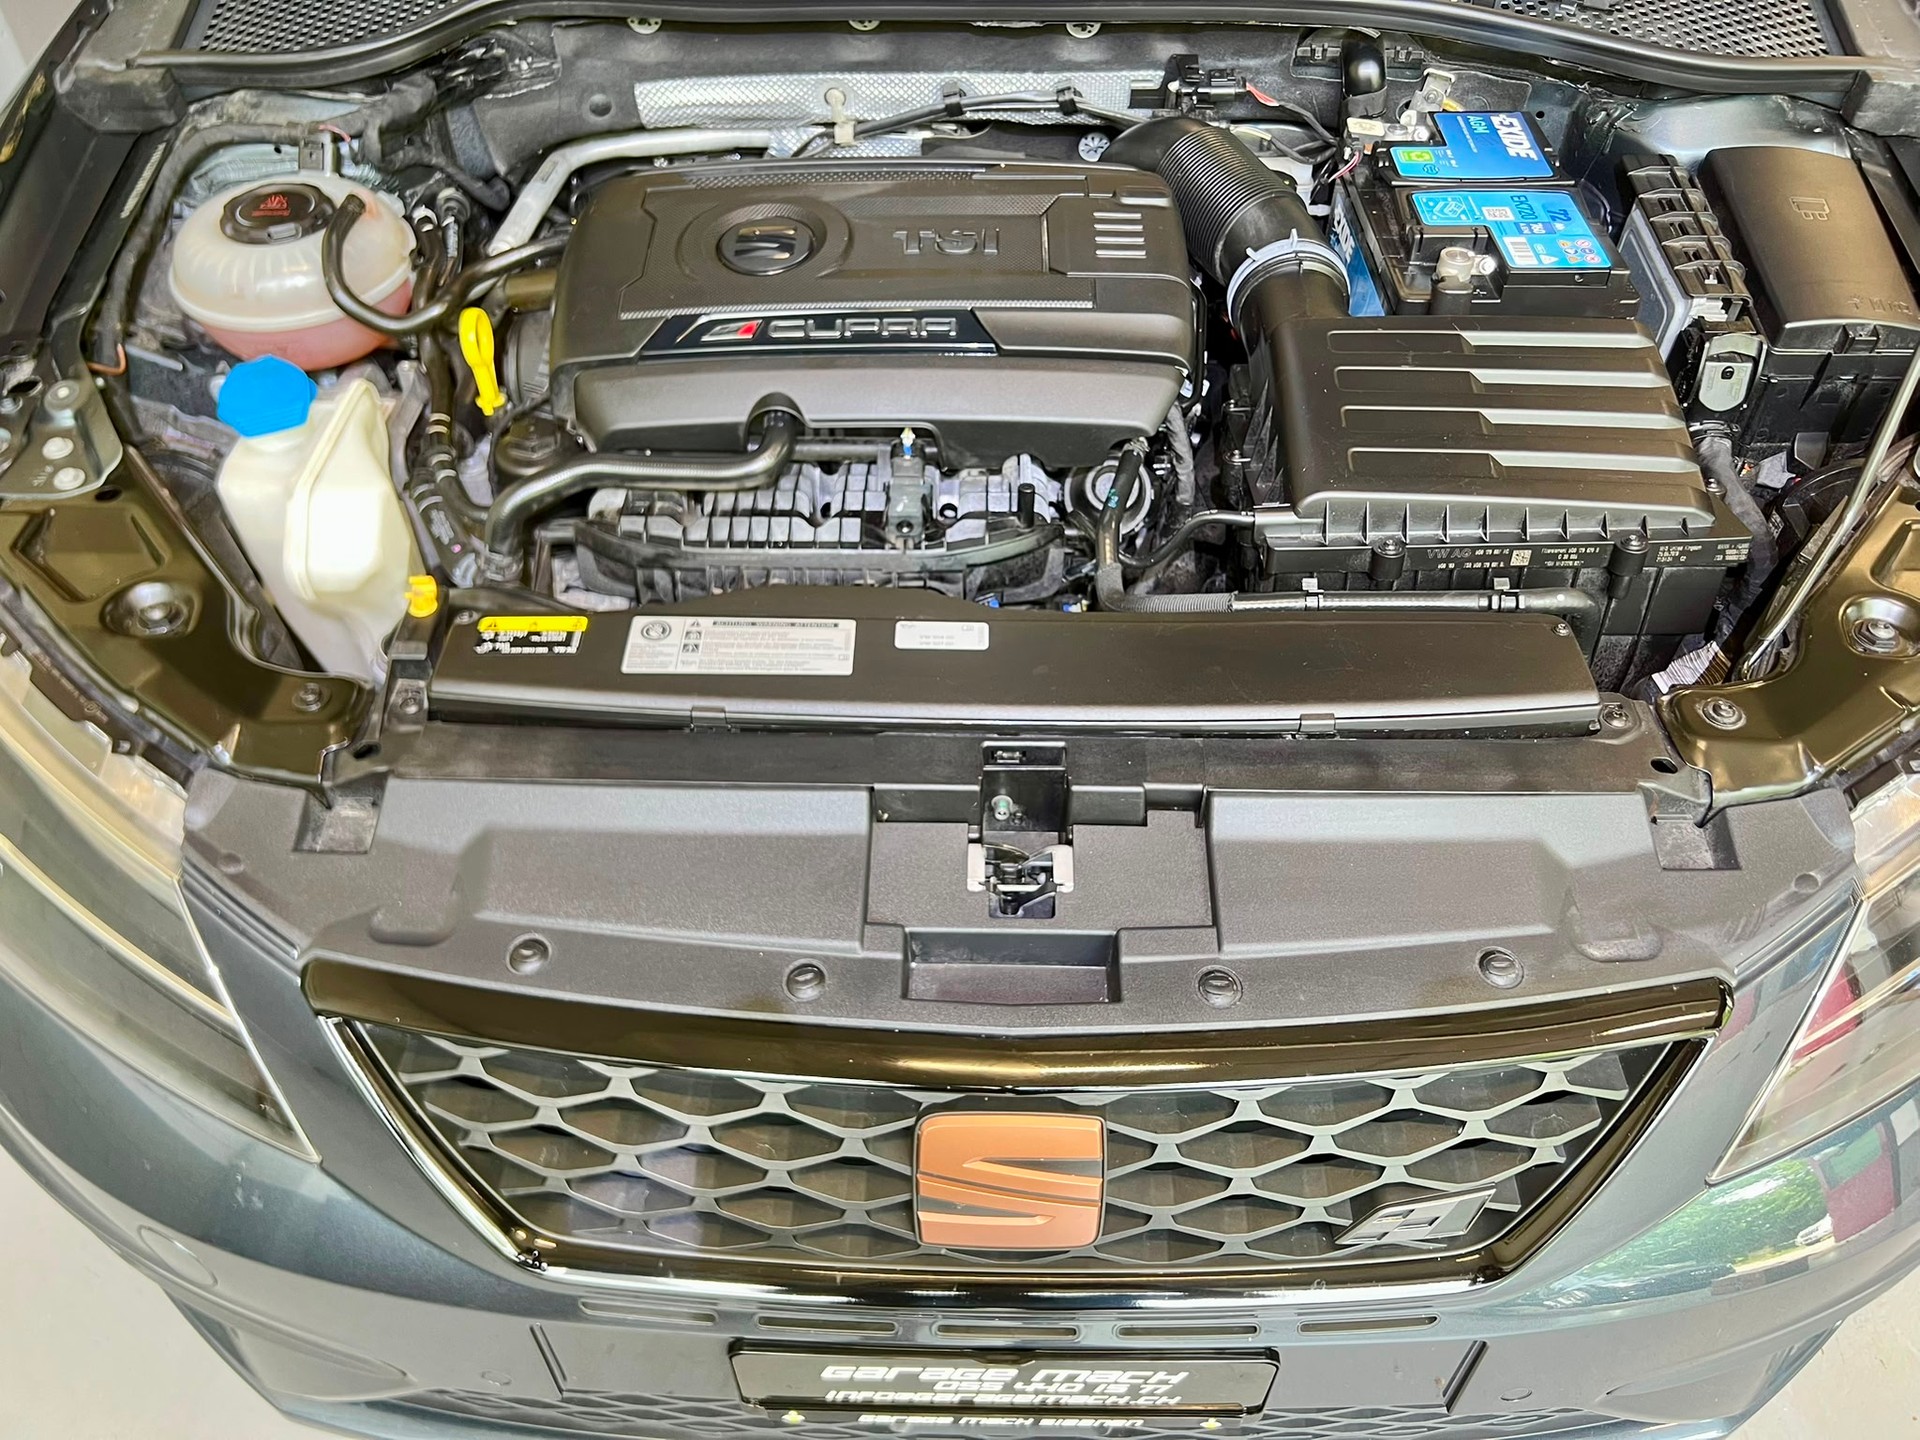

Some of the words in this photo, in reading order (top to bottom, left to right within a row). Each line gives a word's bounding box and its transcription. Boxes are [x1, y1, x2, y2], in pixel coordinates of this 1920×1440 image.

[1467, 115, 1490, 134] AGM
[1490, 113, 1538, 160] EXIDE
[1510, 195, 1538, 220] EK720
[1546, 209, 1572, 222] 72
[893, 228, 1000, 255] TSI
[768, 317, 957, 339] CUPRA
[1427, 549, 1450, 559] VW
[1451, 548, 1472, 558] AG
